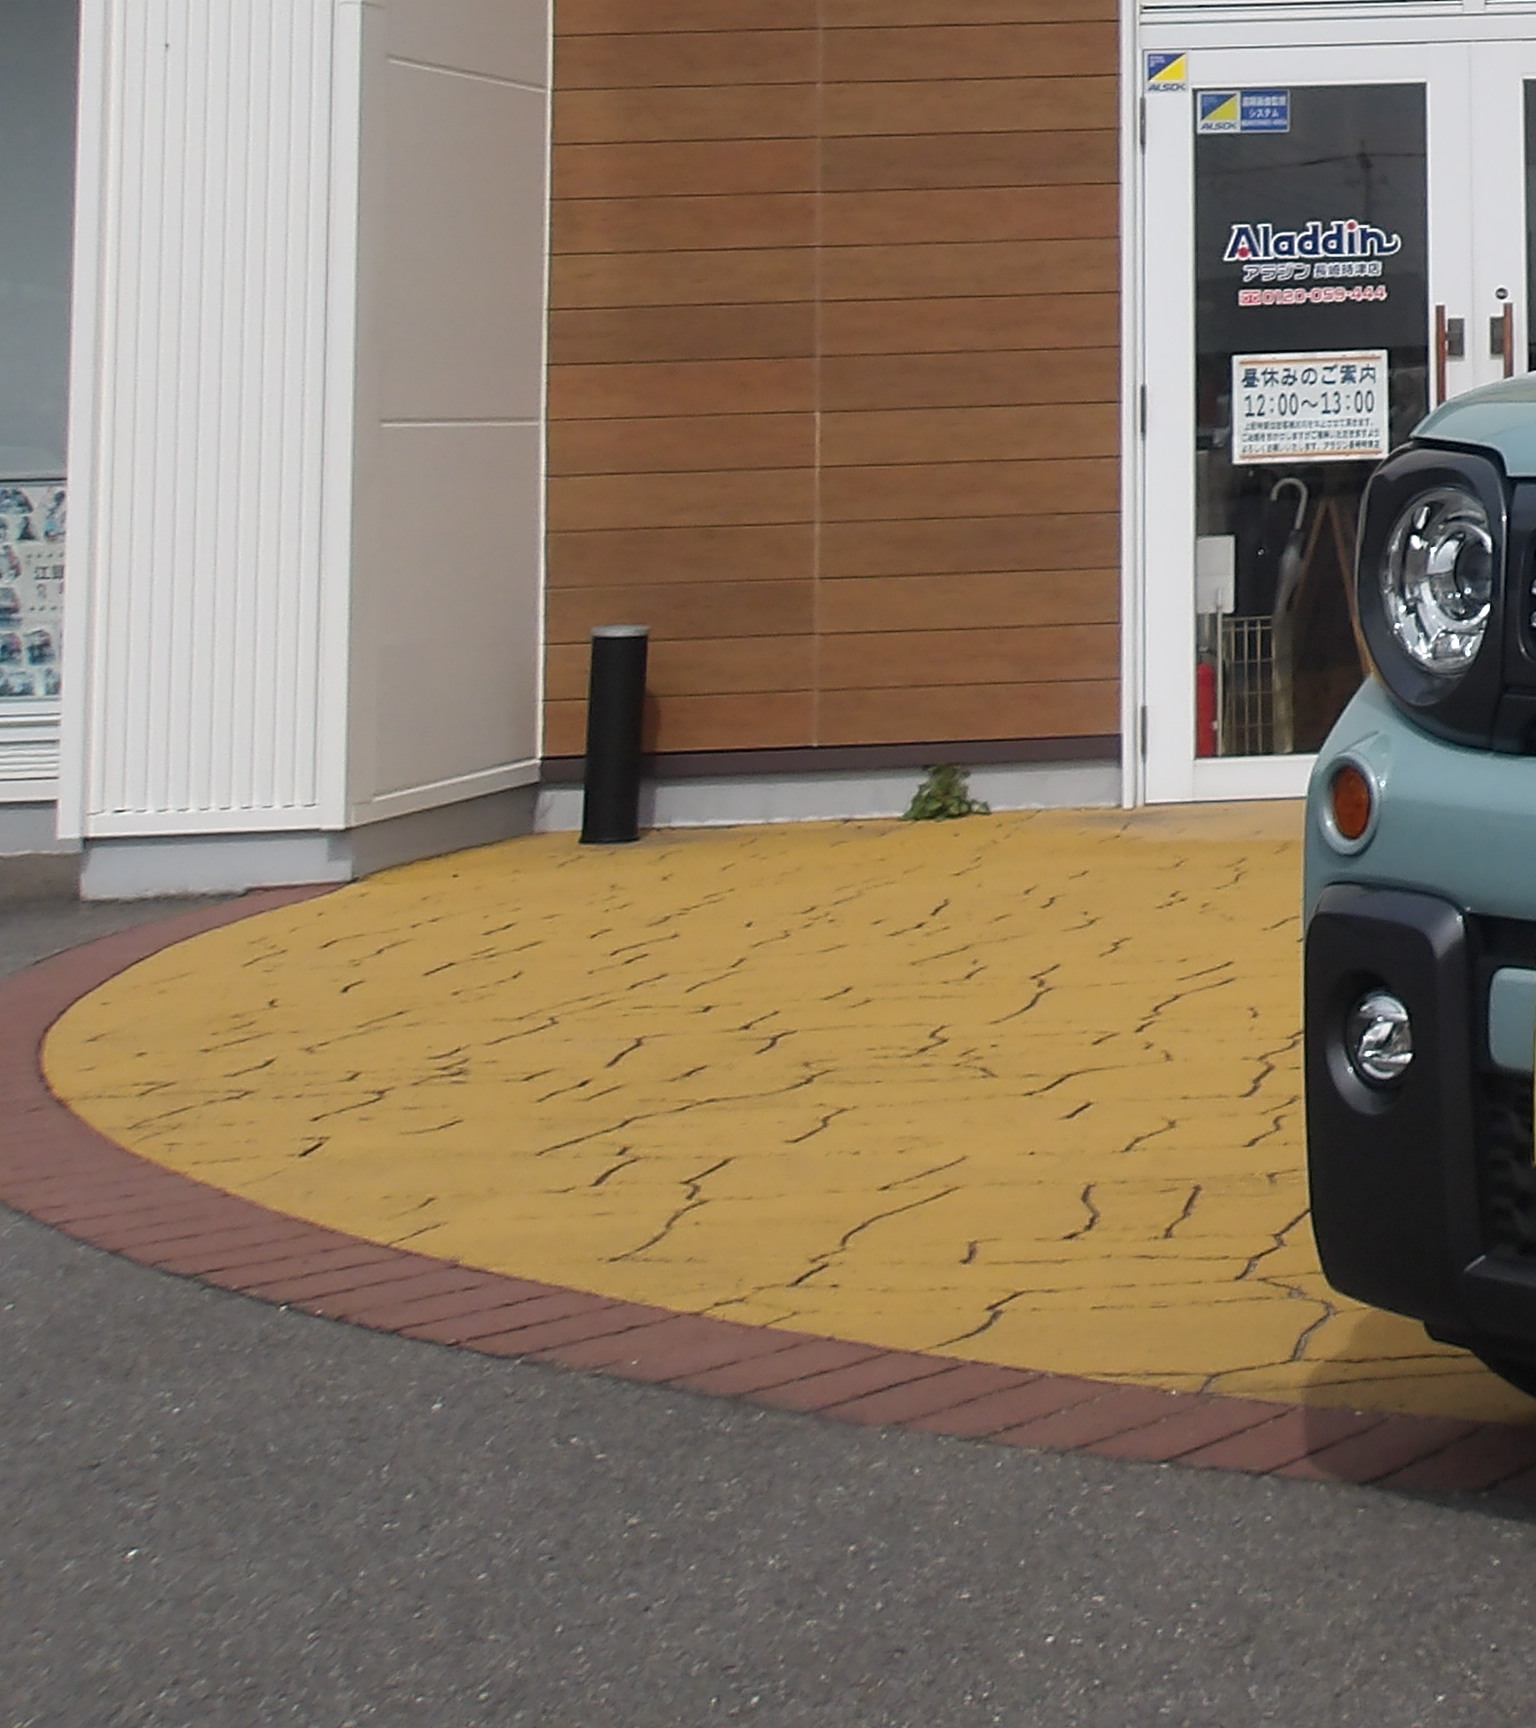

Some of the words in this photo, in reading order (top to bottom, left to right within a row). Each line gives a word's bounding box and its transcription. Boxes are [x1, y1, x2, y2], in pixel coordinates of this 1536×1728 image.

[1224, 219, 1402, 261] Aladdin
[1242, 263, 1311, 282] アラジン
[1241, 363, 1378, 389] 昼休みのご案内
